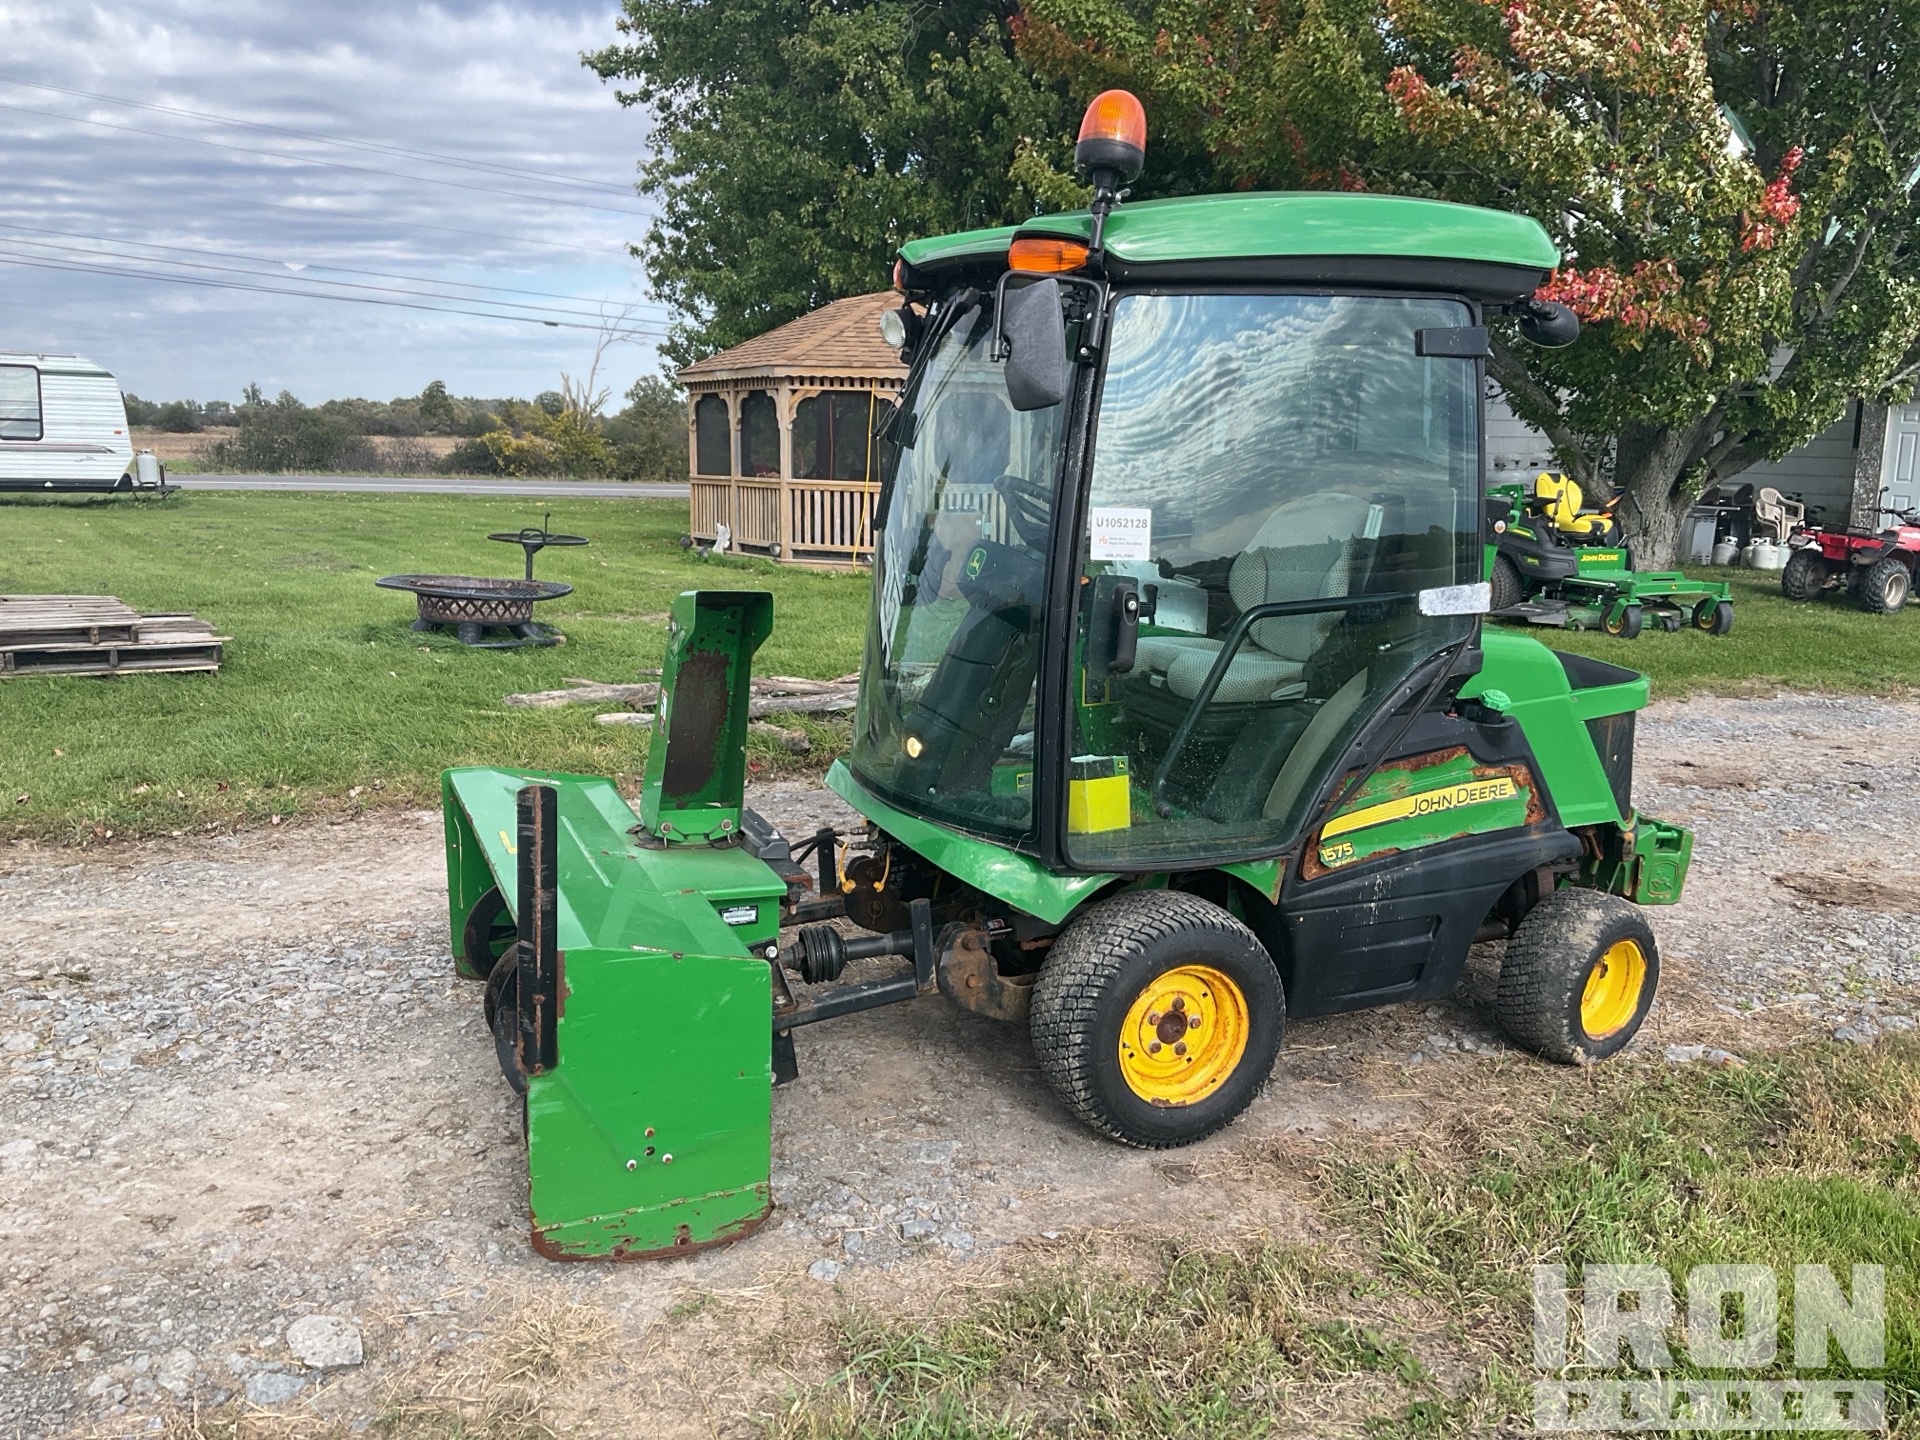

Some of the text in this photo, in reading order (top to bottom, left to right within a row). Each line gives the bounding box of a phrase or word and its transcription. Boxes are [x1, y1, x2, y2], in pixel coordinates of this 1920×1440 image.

[1096, 518, 1148, 529] U1052128
[1408, 783, 1509, 815] JOHN DEERE
[1321, 842, 1354, 862] 1575
